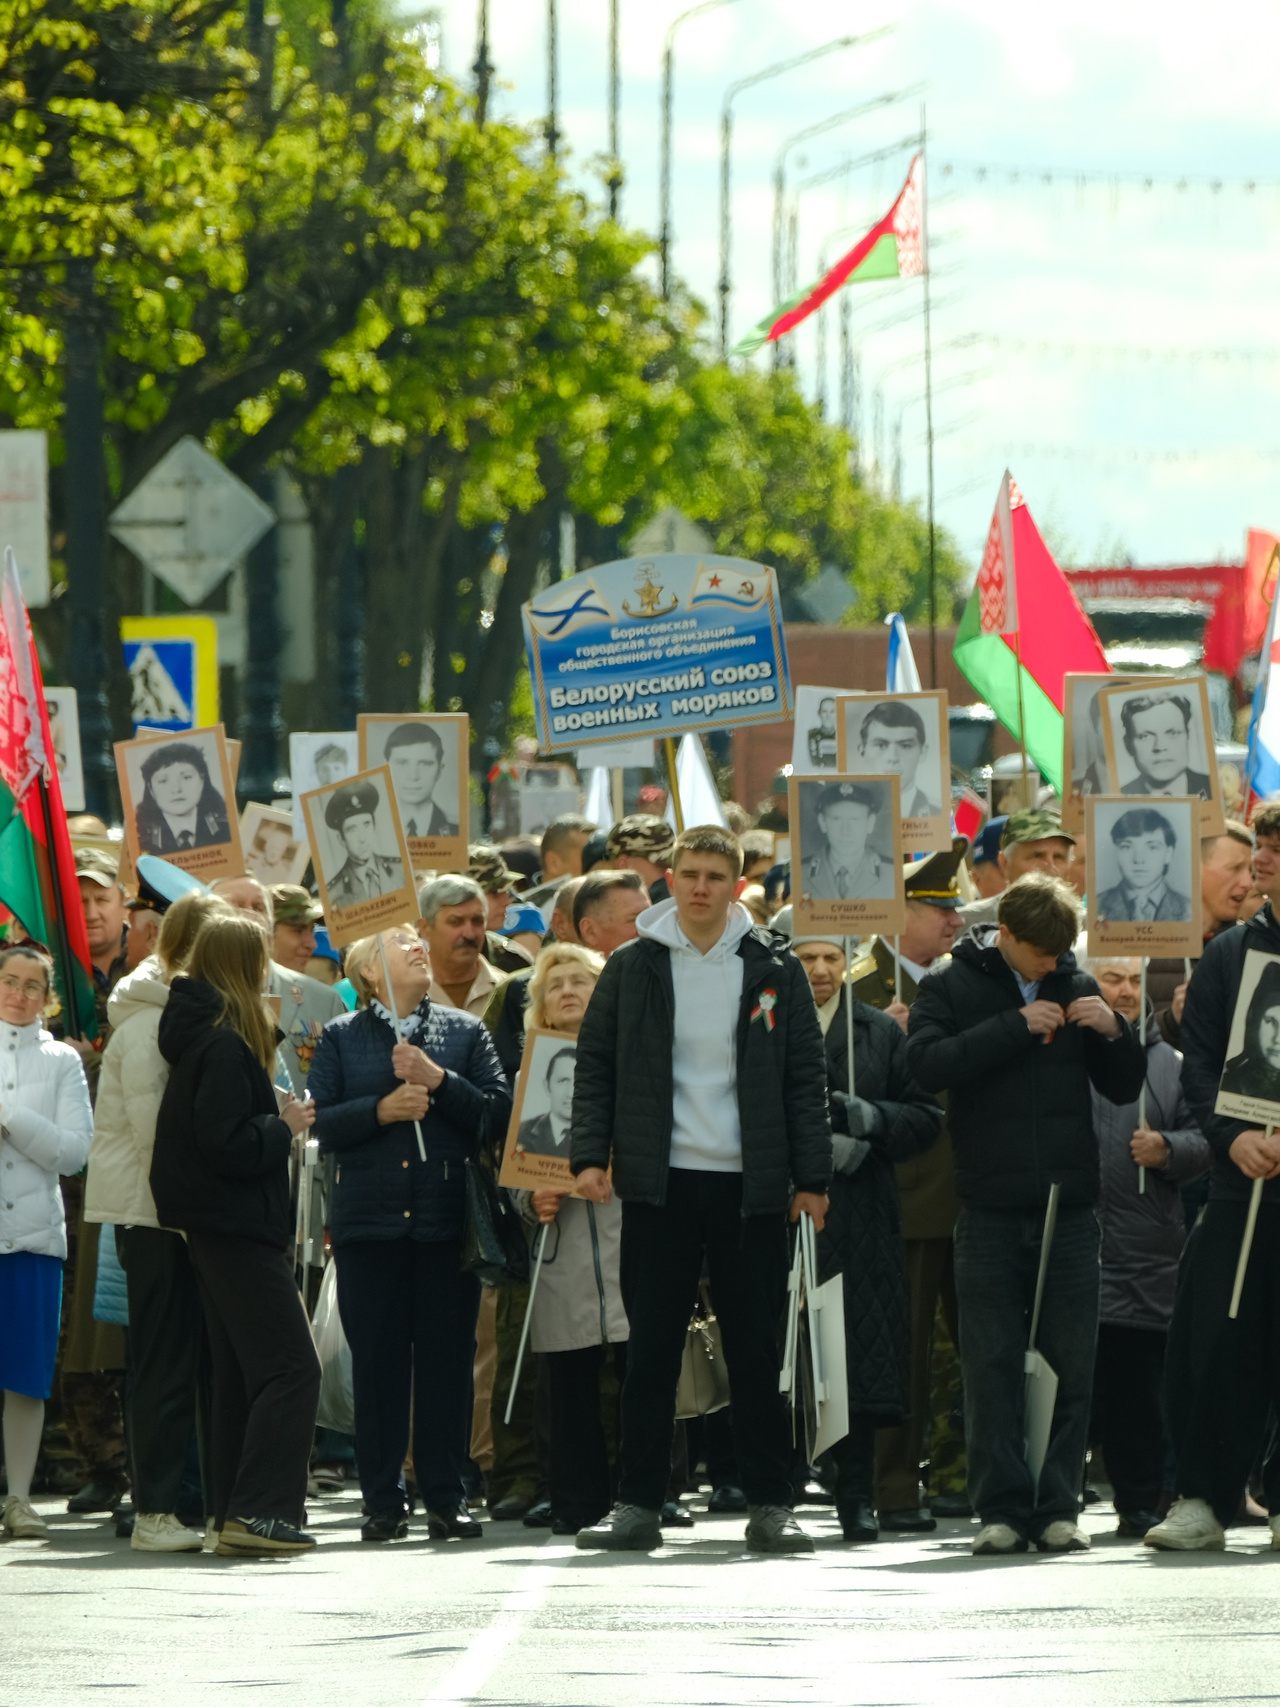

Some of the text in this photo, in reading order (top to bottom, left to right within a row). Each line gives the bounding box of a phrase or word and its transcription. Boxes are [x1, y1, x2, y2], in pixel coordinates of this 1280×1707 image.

[576, 625, 736, 659] городская организация
[611, 618, 698, 641] Борисовская
[558, 634, 757, 673] общественного объединения
[550, 661, 773, 710] Белорусский союз
[553, 684, 776, 734] военных моряков
[831, 903, 866, 913] СУШКО
[1134, 925, 1153, 934] УСС
